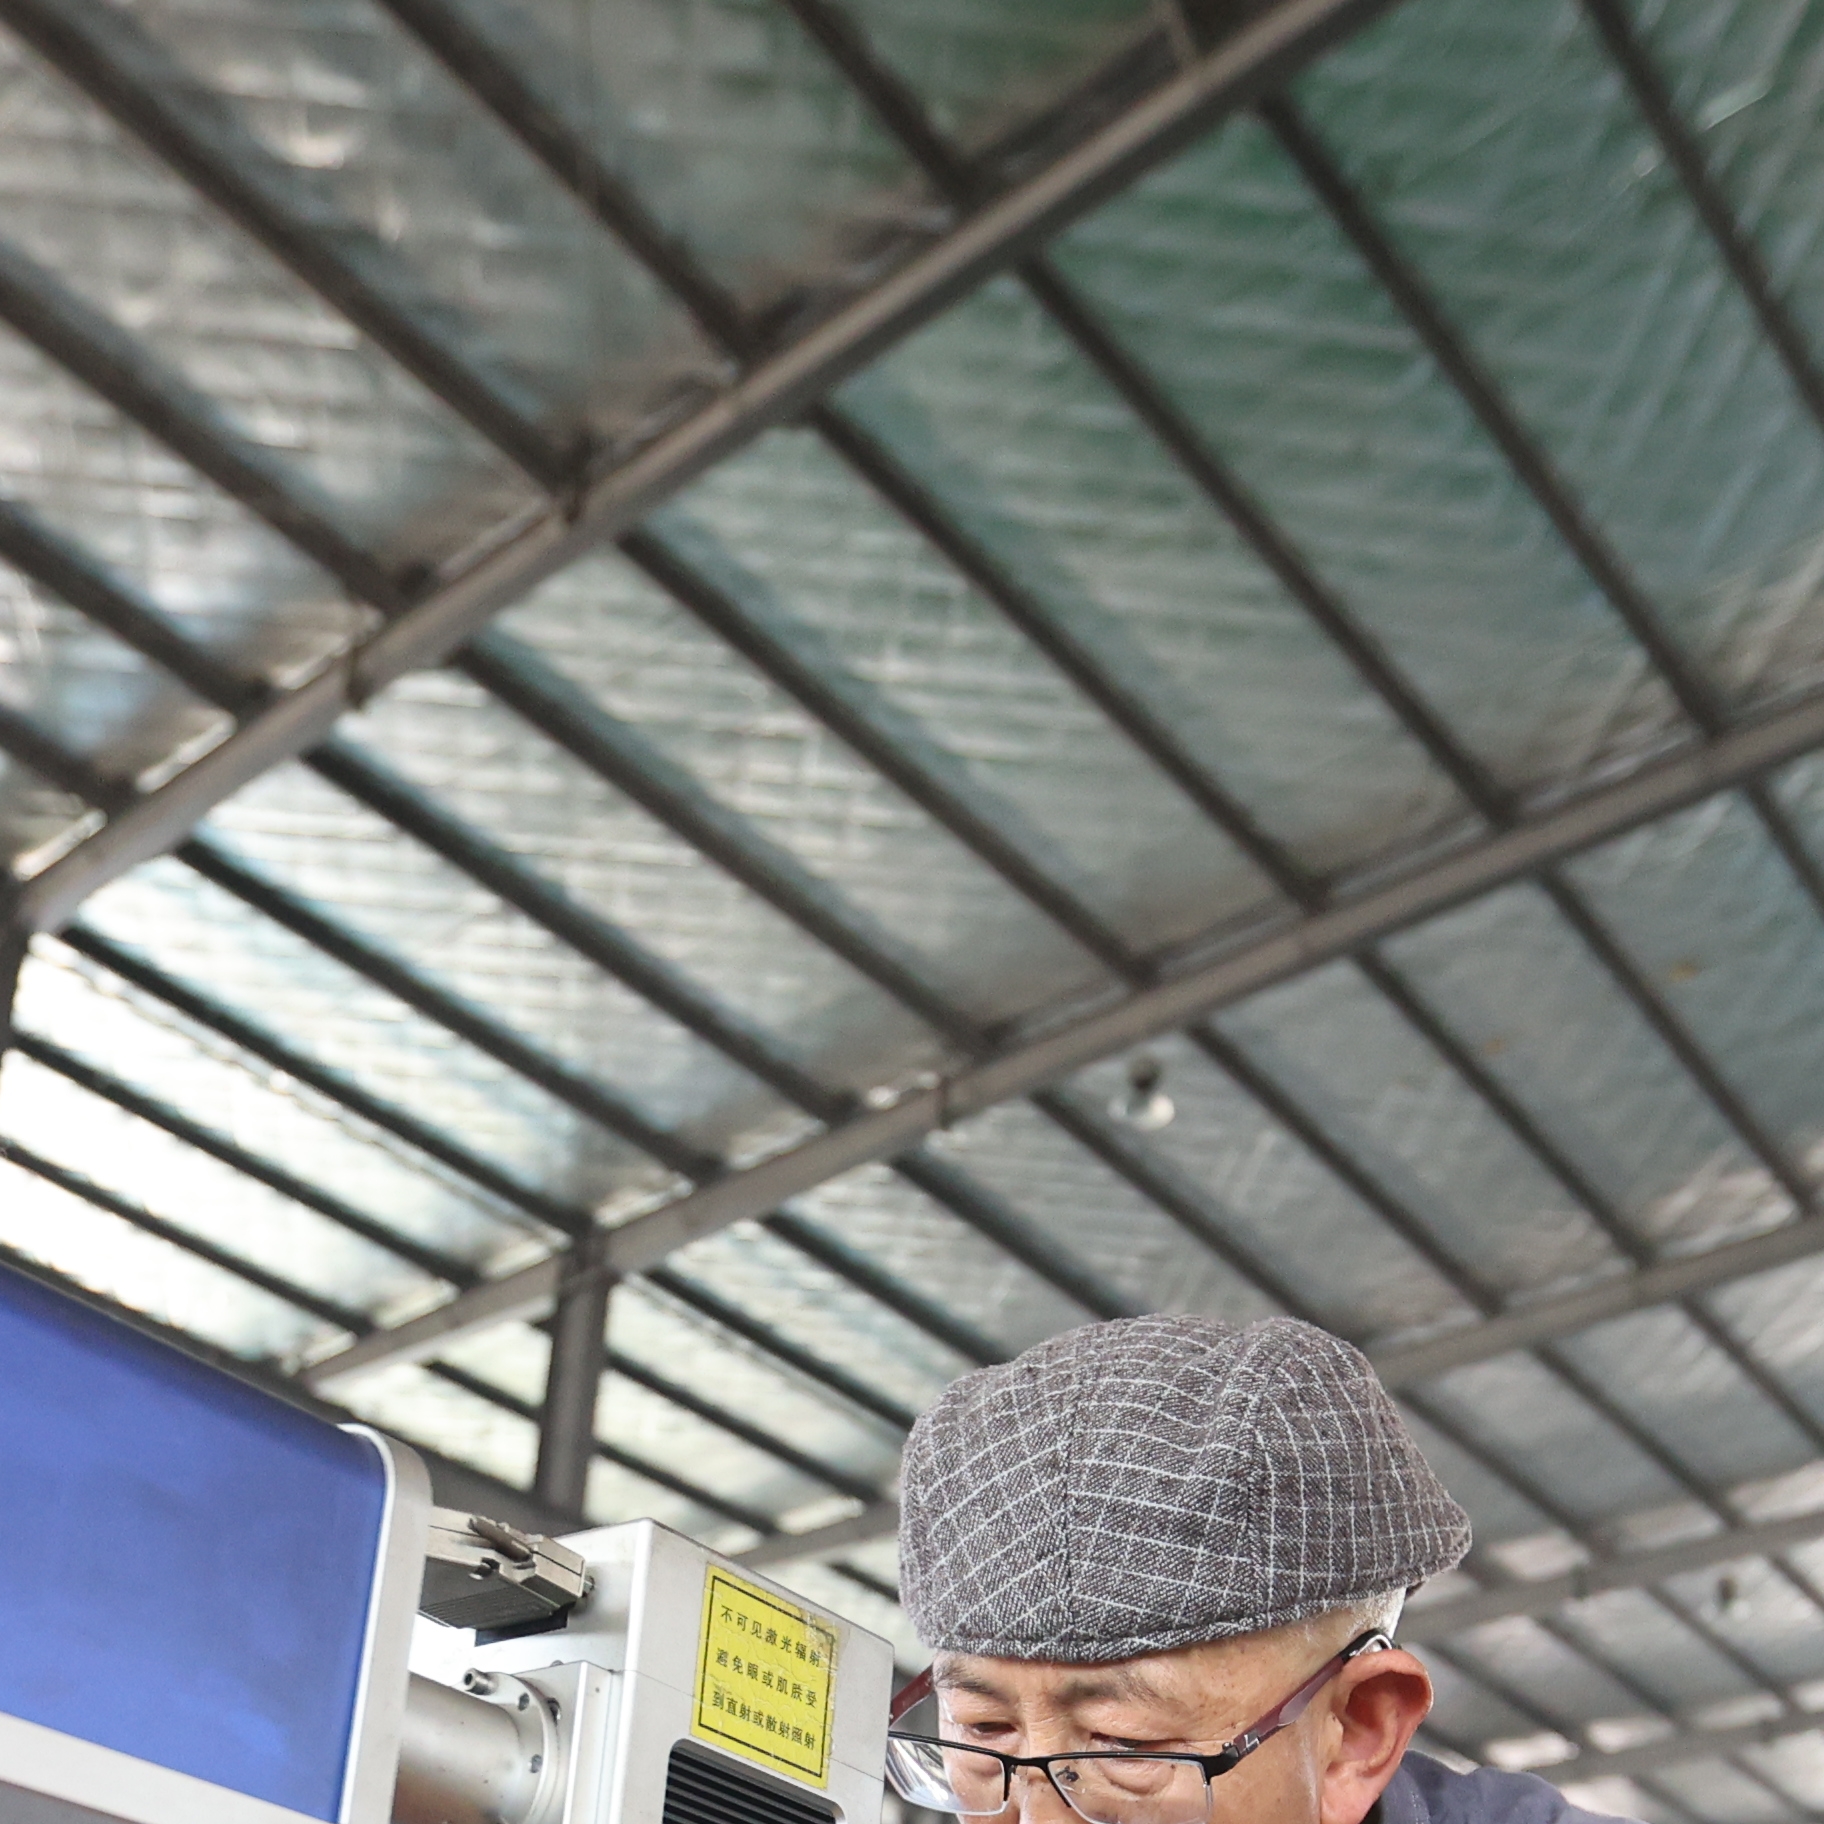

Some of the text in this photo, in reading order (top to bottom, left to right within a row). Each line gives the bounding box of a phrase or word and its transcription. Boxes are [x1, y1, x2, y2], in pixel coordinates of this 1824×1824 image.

[720, 1604, 822, 1668] 不可见激光辐射
[716, 1647, 818, 1709] 避免眼或肌肤受
[712, 1690, 816, 1751] 到直射或散射照射
